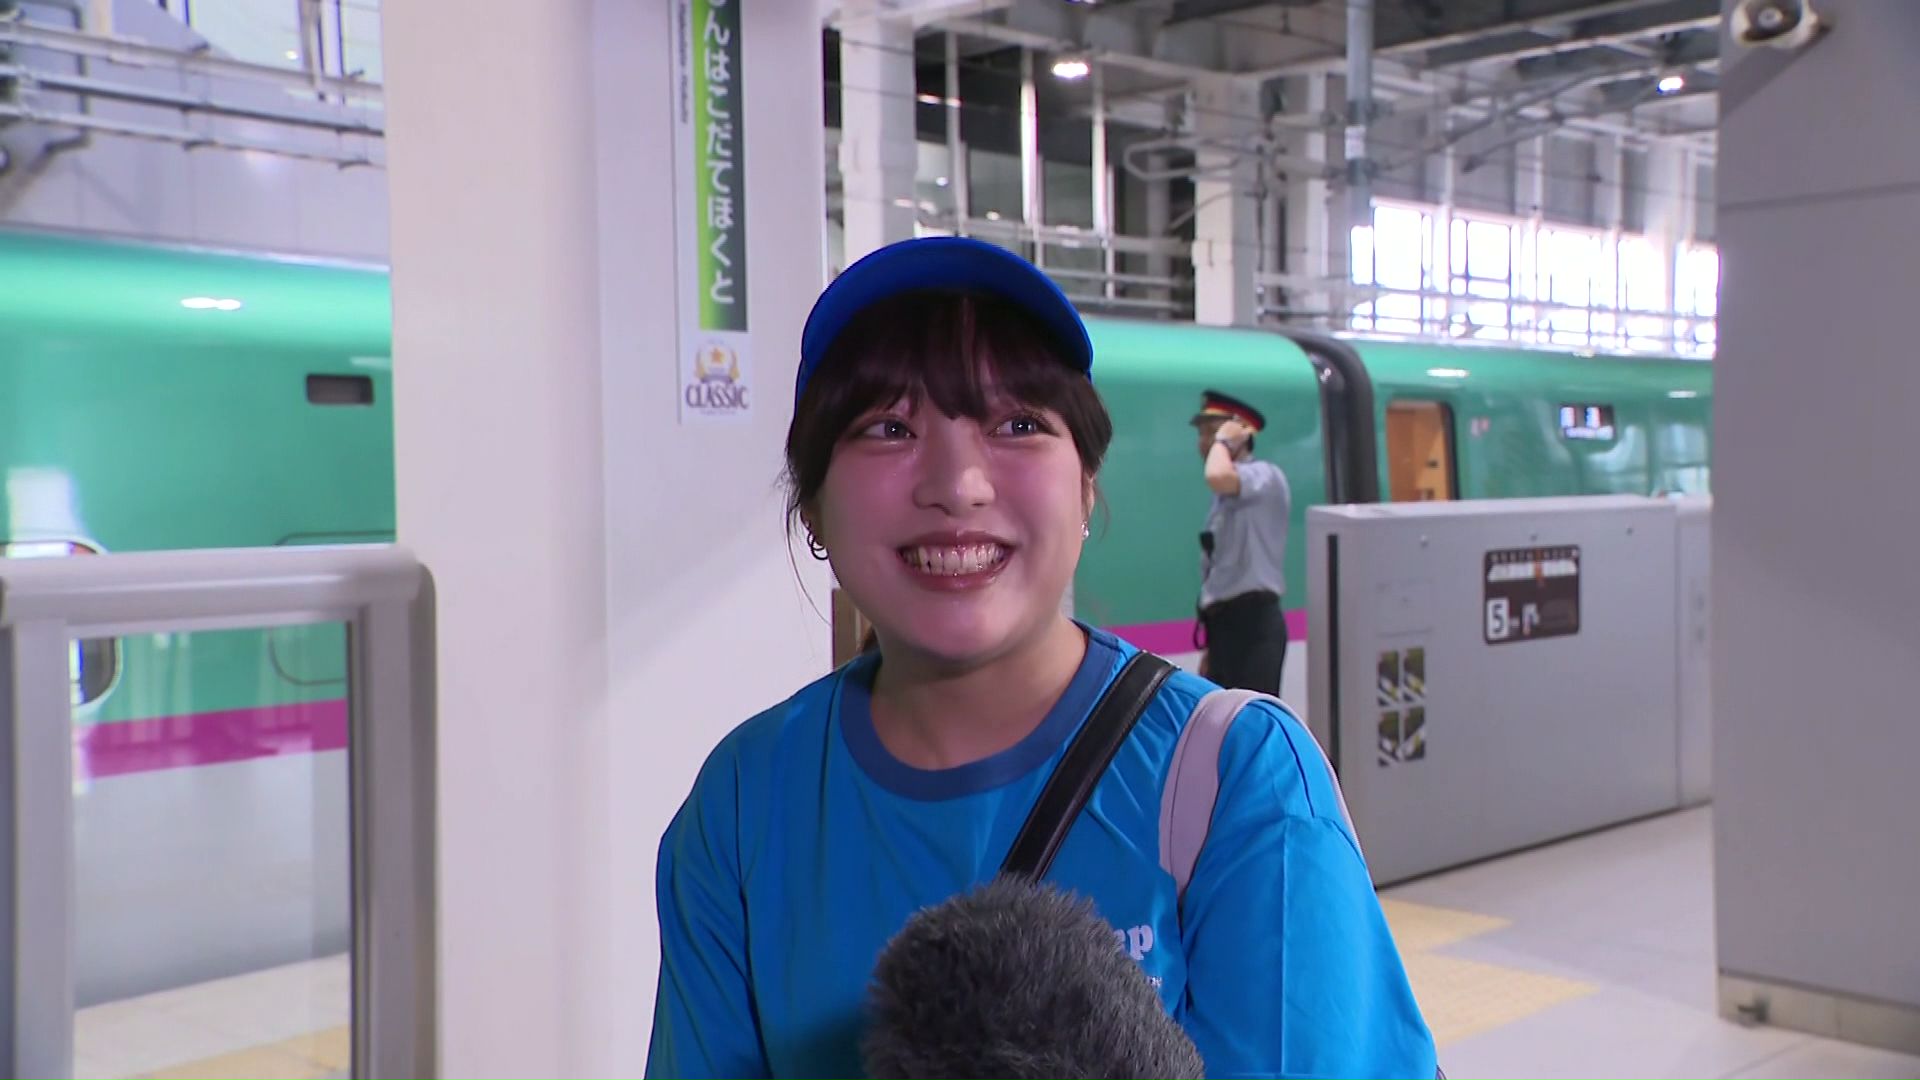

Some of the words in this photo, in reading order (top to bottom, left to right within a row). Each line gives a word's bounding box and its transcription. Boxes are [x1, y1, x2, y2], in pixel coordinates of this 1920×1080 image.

[704, 0, 735, 304] んはこだてほくと
[685, 383, 750, 410] CLASSIC
